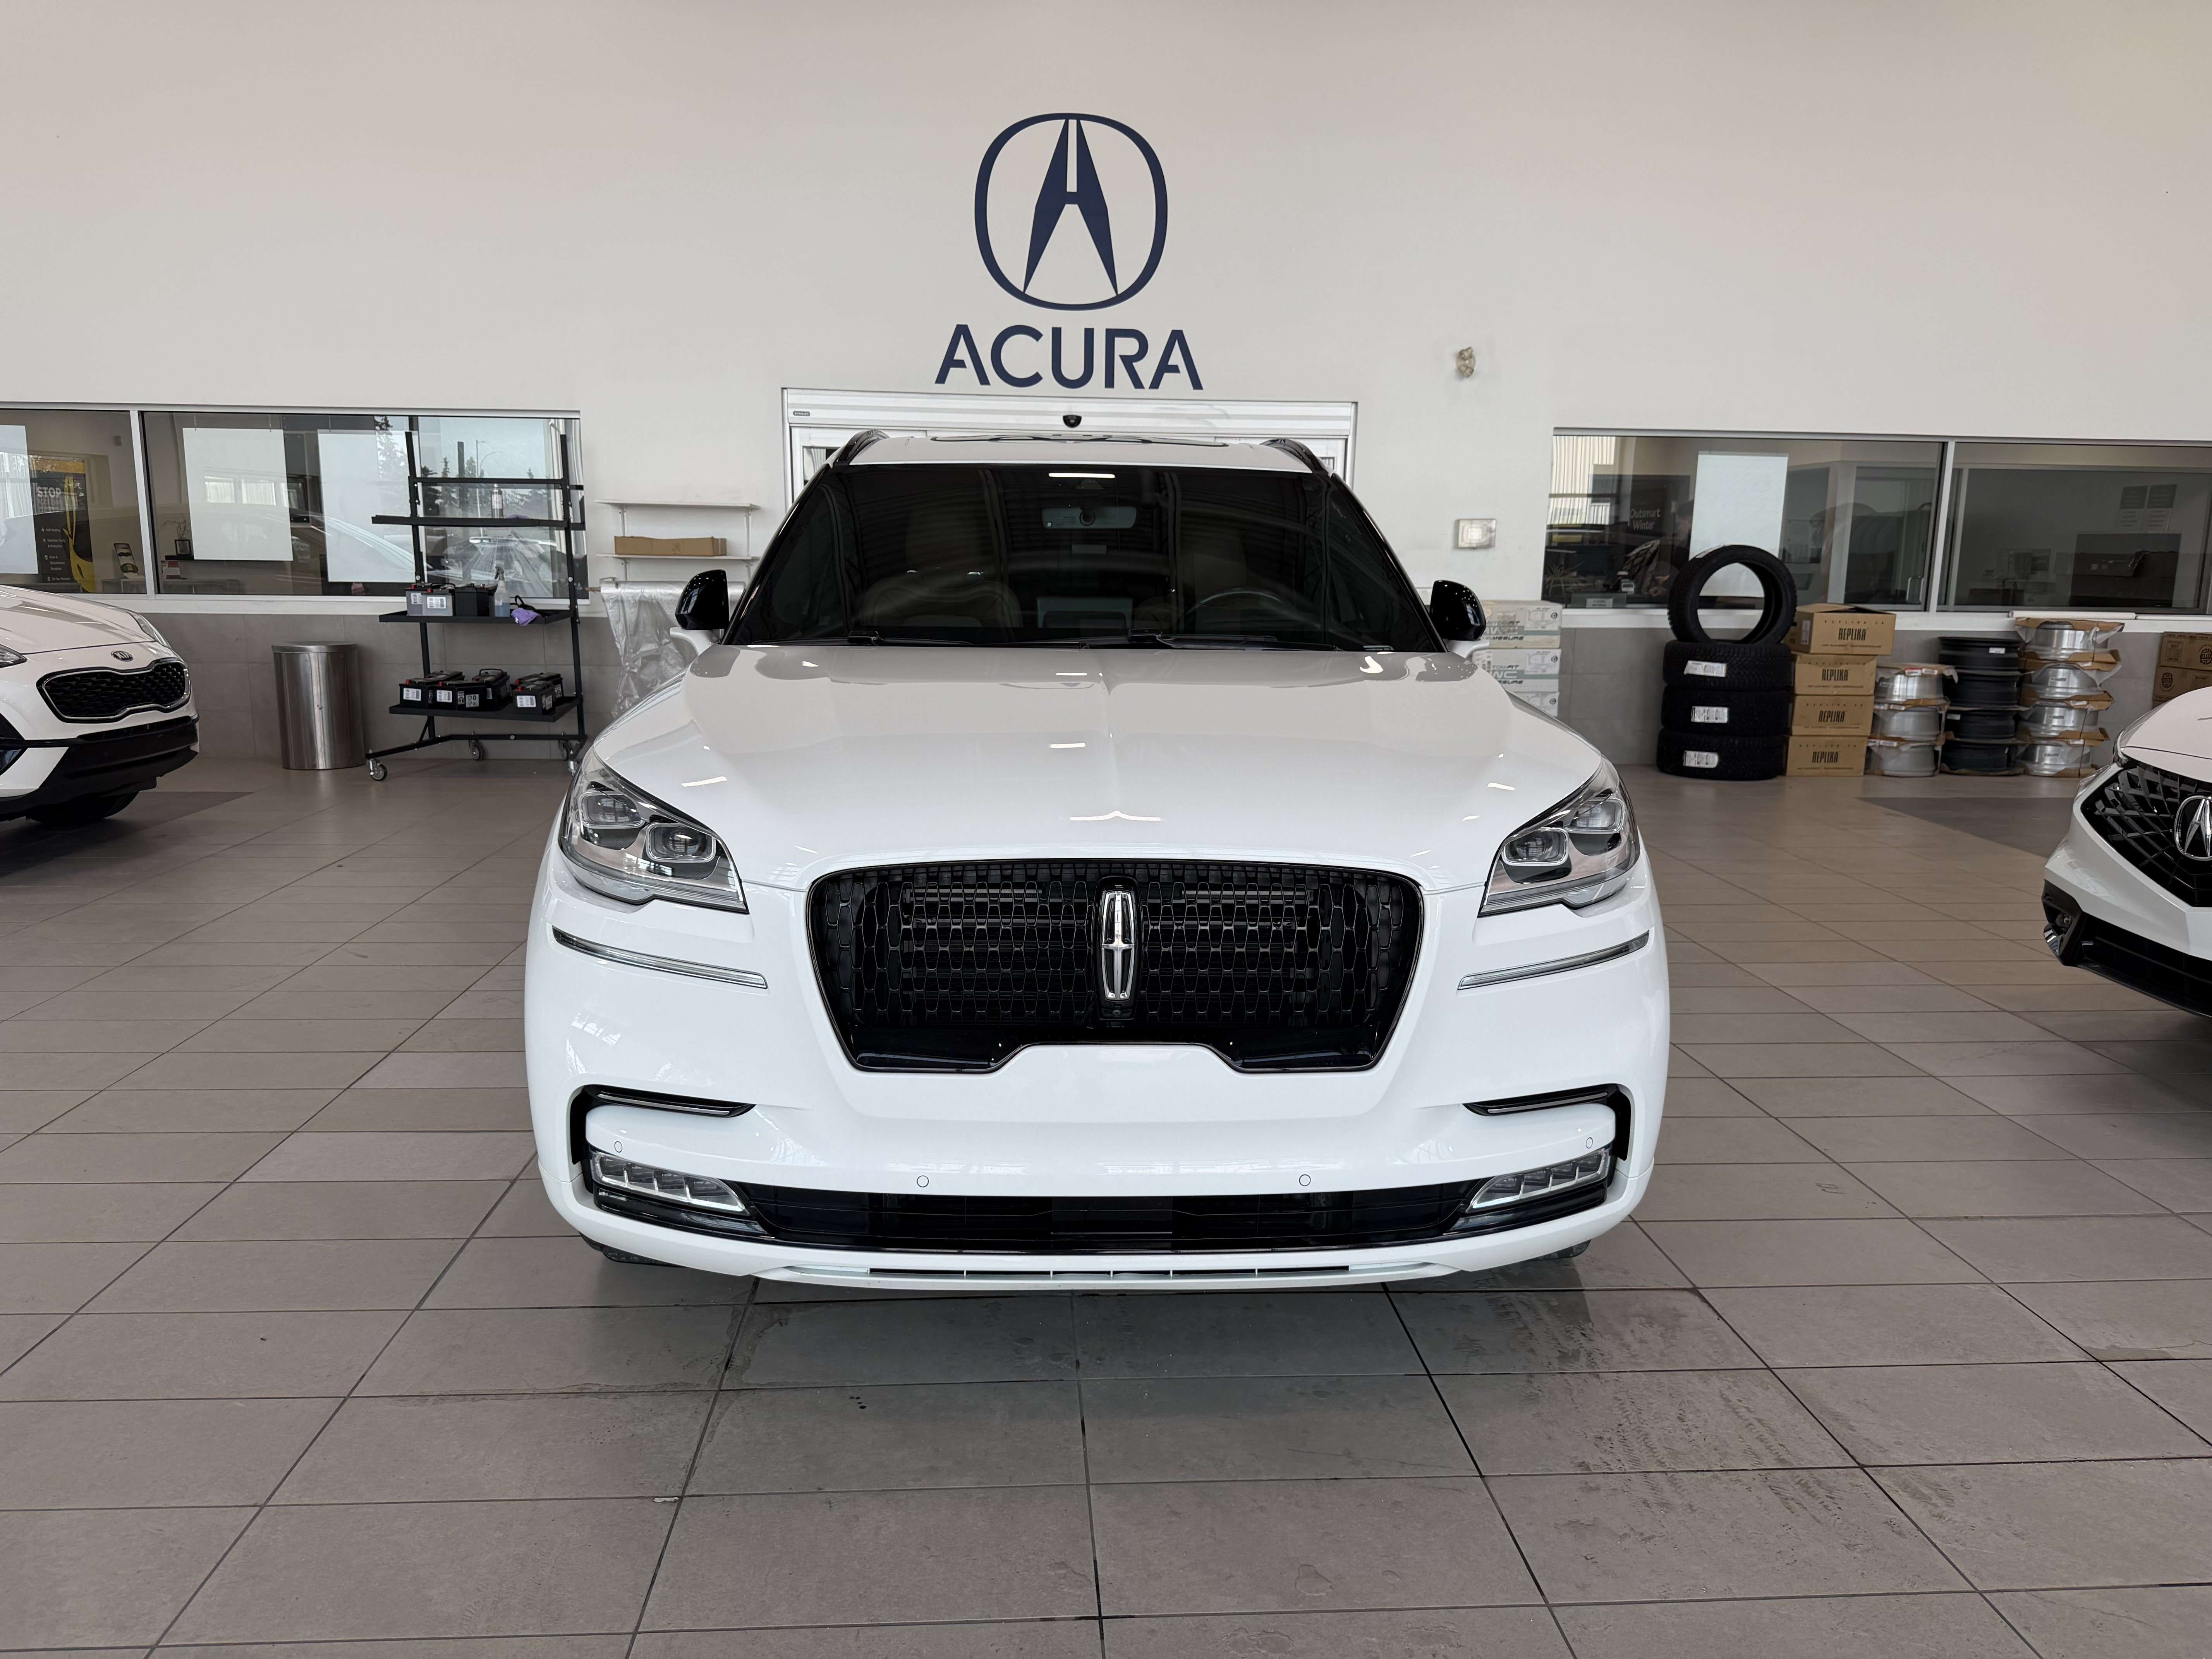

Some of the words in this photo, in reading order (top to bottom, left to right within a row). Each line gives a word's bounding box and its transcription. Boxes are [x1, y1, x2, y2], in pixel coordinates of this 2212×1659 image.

[934, 324, 1204, 390] ACURA
[37, 486, 61, 498] STOP
[1630, 508, 1661, 518] Outsmart
[1633, 520, 1655, 530] Winter
[1838, 628, 1866, 641] REPLIKA
[1822, 669, 1848, 681] REPLIKA
[1818, 710, 1845, 722] REPLIKA
[1812, 751, 1839, 763] REPLIKA
